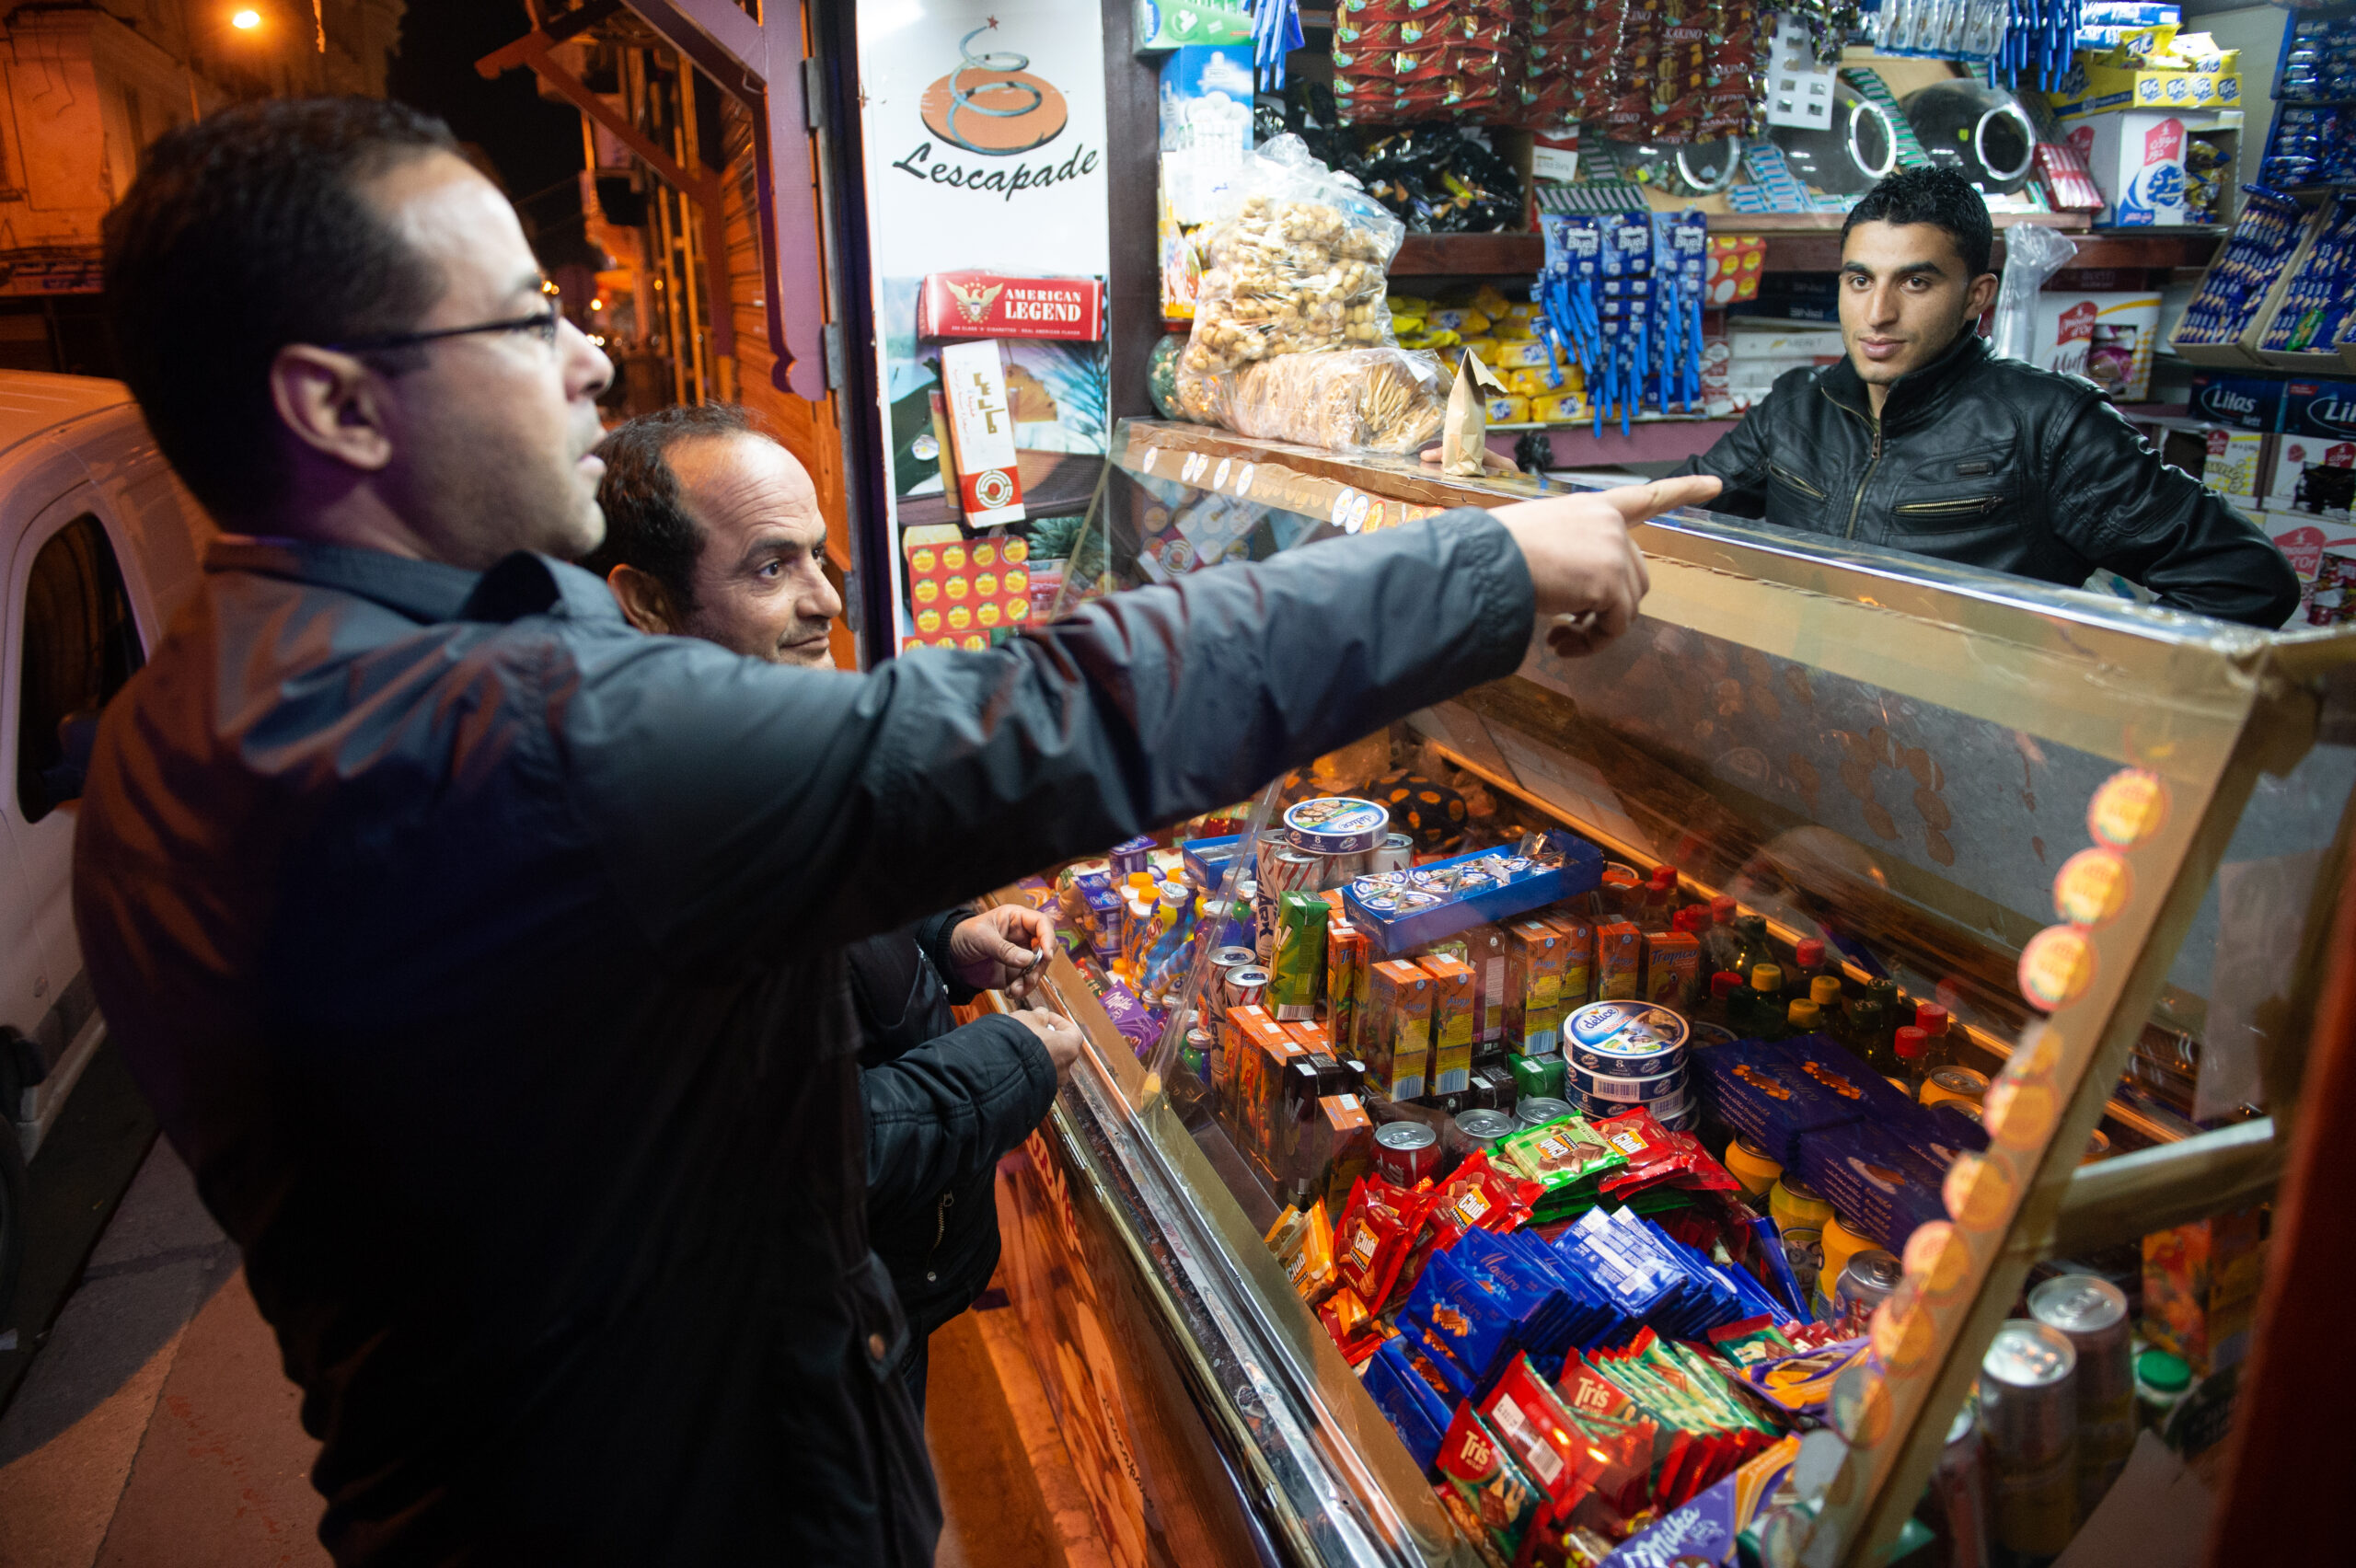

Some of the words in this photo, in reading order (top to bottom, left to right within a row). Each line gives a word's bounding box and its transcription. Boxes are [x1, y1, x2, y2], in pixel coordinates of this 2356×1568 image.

[1663, 29, 1703, 40] KAKINO
[2127, 32, 2154, 58] TUC
[2140, 78, 2160, 94] TUC
[2167, 78, 2187, 94] TUC
[2218, 78, 2237, 94] TUC
[893, 143, 1099, 202] Lescapade
[1004, 288, 1081, 302] AMERICAN
[1005, 300, 1081, 322] LEGEND
[2212, 389, 2258, 413] Lilas
[1314, 835, 1322, 844] 8
[1650, 949, 1698, 966] Tropico
[1583, 1007, 1617, 1030] délice
[1616, 1059, 1624, 1068] 8
[1540, 1137, 1570, 1158] Club
[1611, 1133, 1643, 1153] Club
[1457, 1192, 1489, 1219] Club
[1354, 1229, 1377, 1258] Club
[1287, 1252, 1306, 1282] Club
[1480, 1251, 1519, 1291] Maestro
[1574, 1376, 1611, 1409] Tris
[1460, 1430, 1491, 1466] Tris
[1624, 1506, 1702, 1568] Milka
